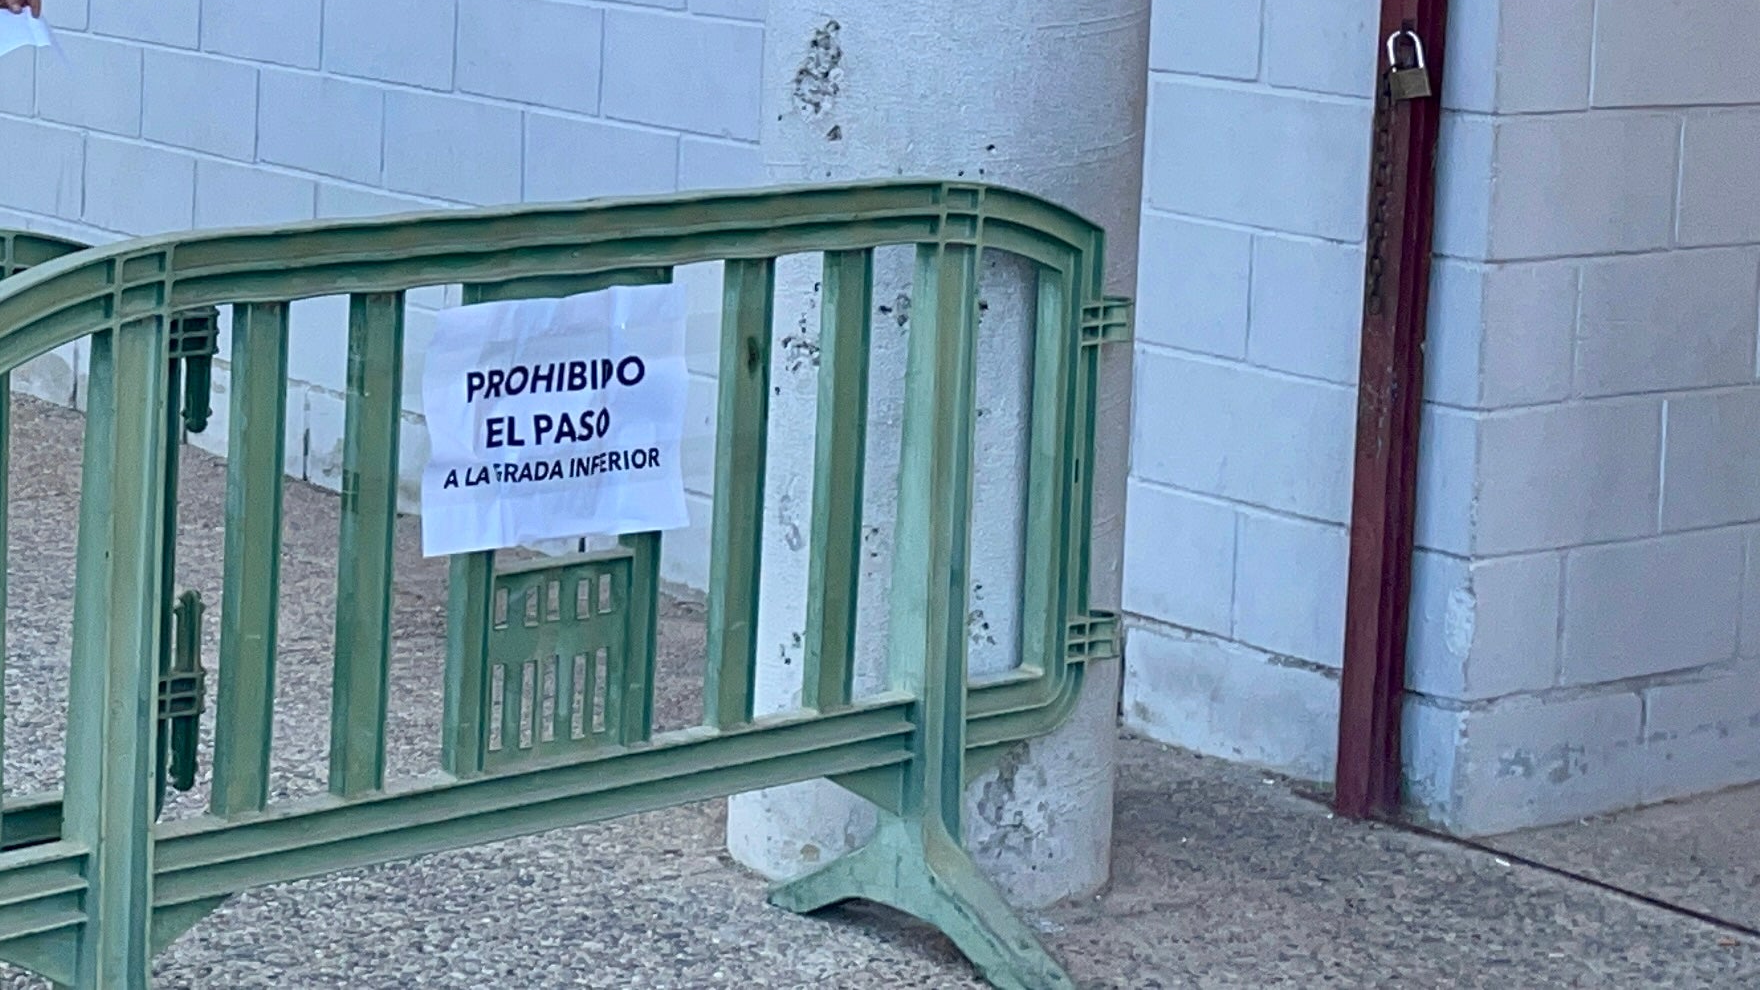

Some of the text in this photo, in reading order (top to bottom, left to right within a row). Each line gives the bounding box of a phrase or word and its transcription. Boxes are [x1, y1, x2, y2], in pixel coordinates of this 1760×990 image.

[466, 355, 645, 403] PROHIBIDO
[486, 407, 610, 448] EL PASO
[443, 448, 660, 489] A LA GRADA INFERIOR
